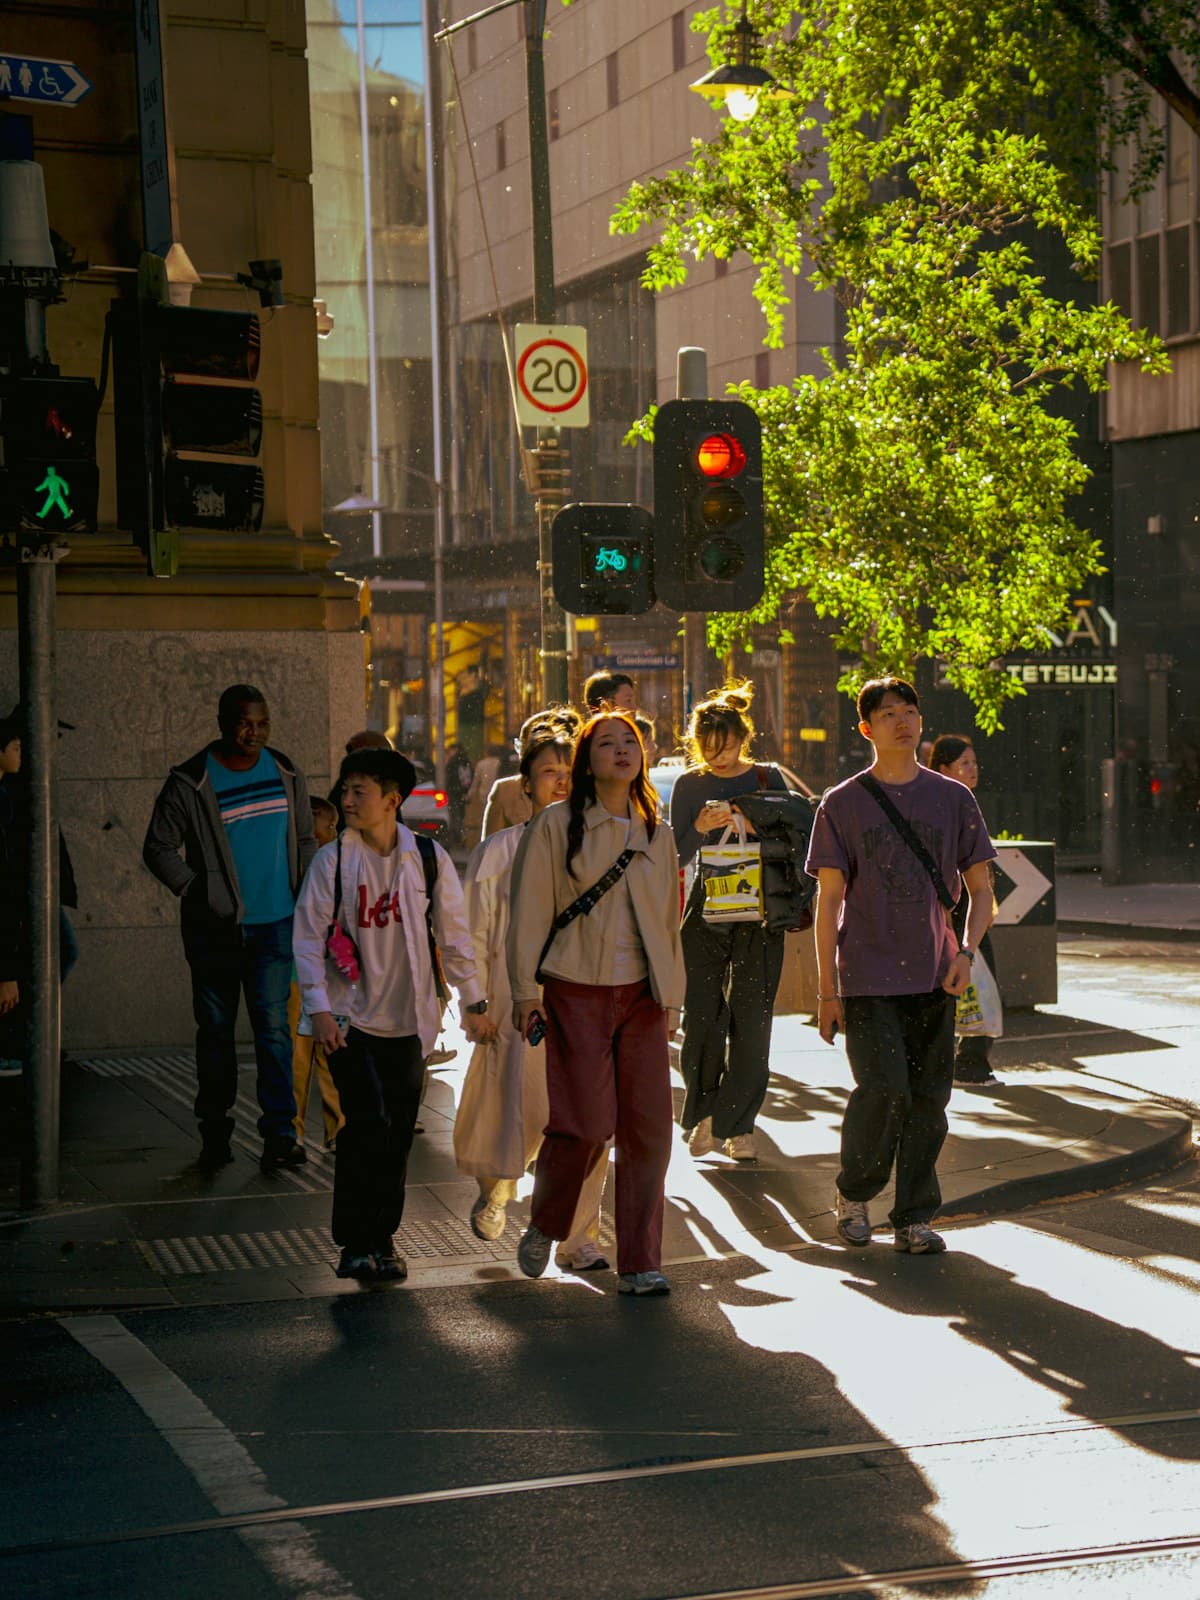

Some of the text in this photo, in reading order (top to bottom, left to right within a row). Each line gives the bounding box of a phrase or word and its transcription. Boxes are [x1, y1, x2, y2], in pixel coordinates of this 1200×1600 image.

[532, 358, 577, 393] 20
[616, 655, 662, 666] Caledonian
[1006, 664, 1118, 684] TETSUJI
[358, 884, 403, 928] Lee
